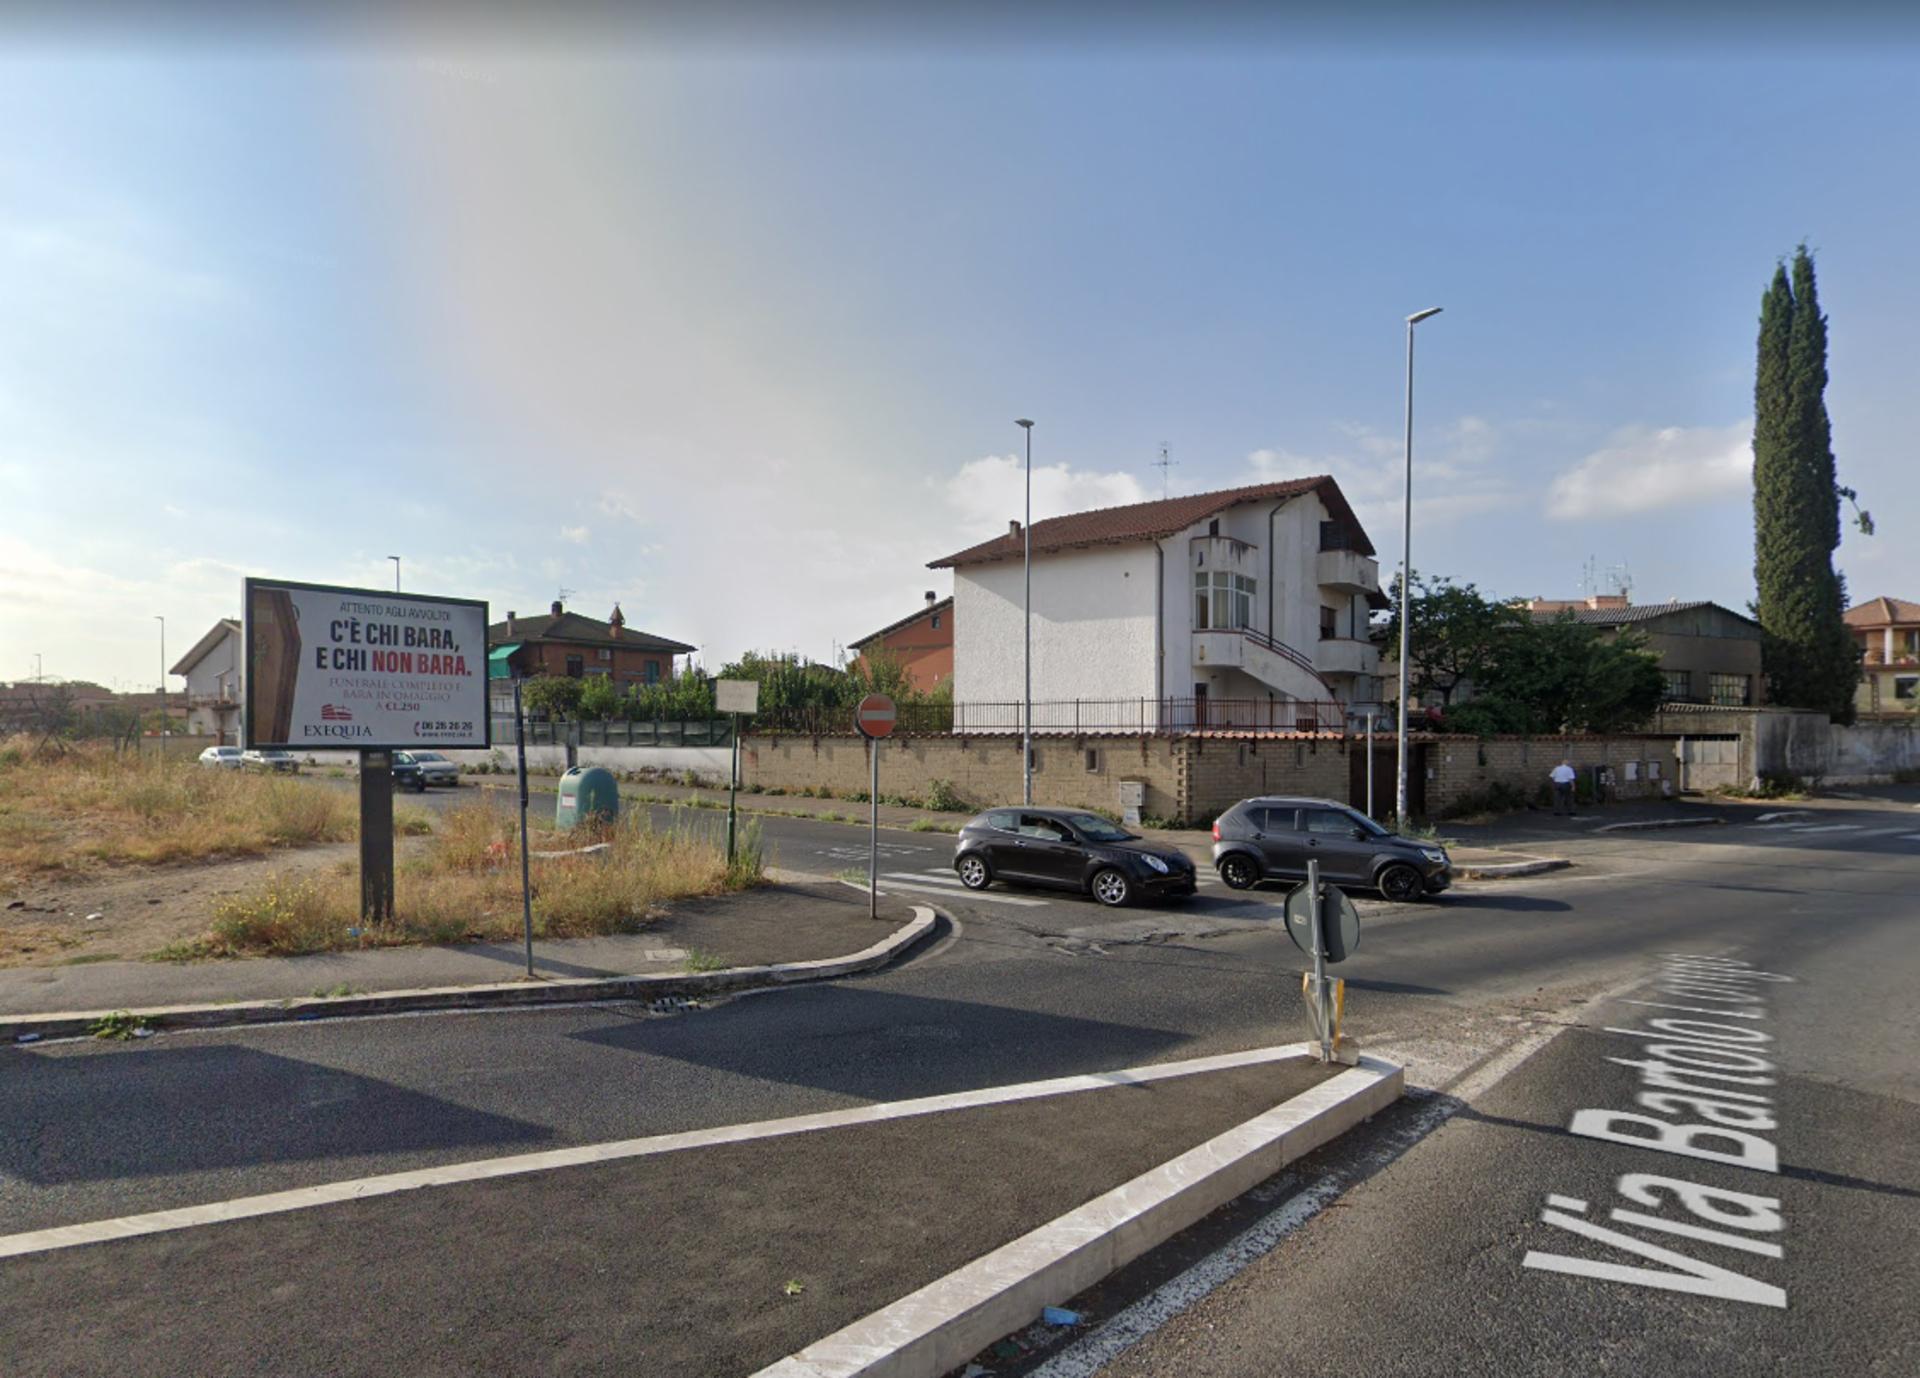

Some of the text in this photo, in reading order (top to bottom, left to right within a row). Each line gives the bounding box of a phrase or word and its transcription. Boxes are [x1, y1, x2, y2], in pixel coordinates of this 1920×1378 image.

[340, 601, 384, 616] ATTENTO
[386, 605, 407, 618] AGLI
[330, 617, 460, 653] C'È CHI BARA,
[316, 647, 472, 677] E CHI NON BARA.
[329, 677, 390, 689] FUNERALE
[392, 680, 453, 692] COMPLETO
[343, 688, 451, 702] BARA IN OMAGGIO
[303, 725, 373, 739] EXEQUIA
